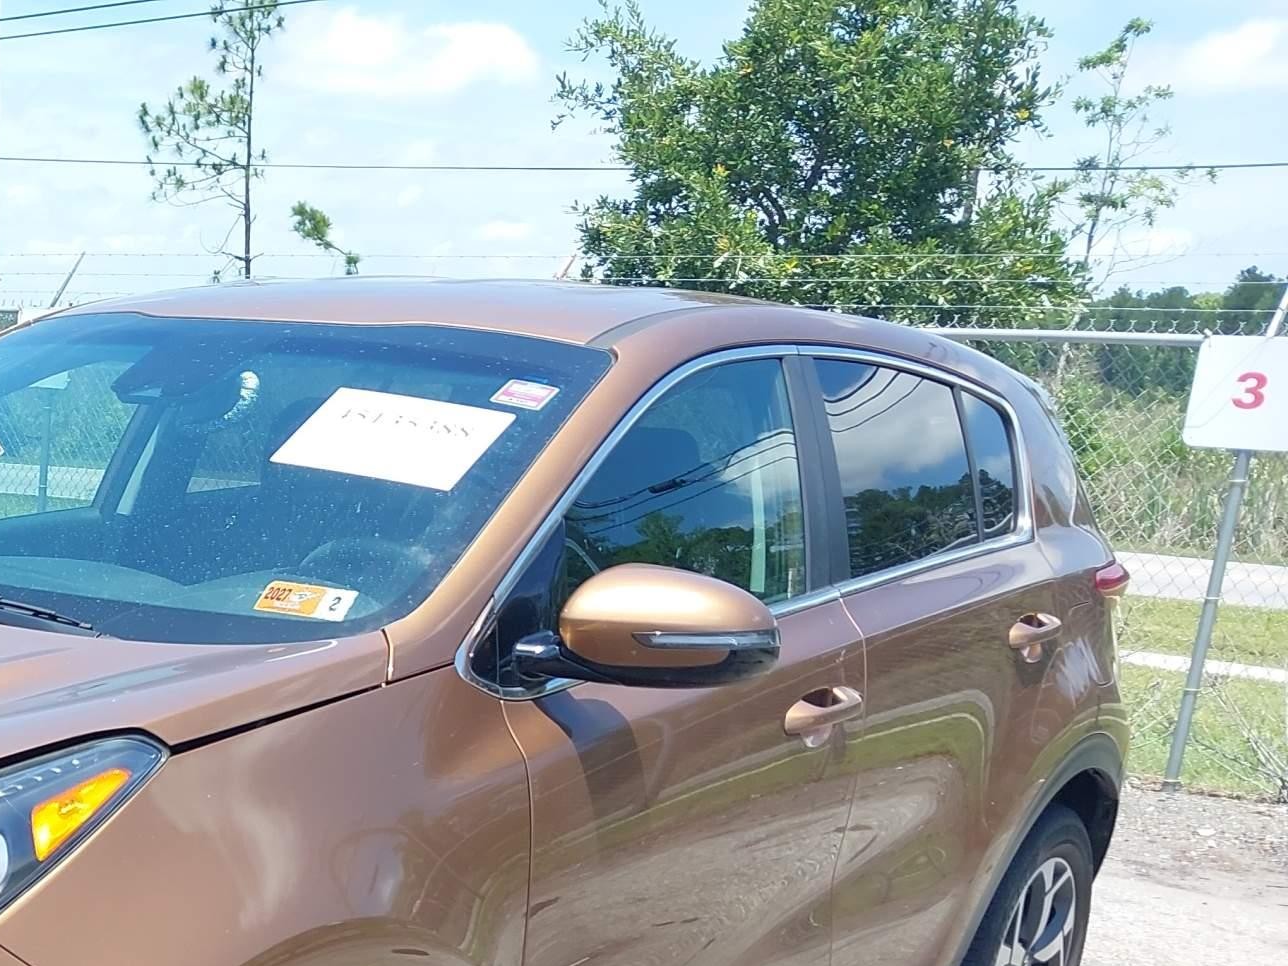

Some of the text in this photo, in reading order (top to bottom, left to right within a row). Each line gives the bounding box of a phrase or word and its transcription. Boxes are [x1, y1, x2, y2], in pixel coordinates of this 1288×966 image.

[1231, 371, 1268, 410] 3
[263, 586, 294, 602] 2027
[328, 596, 343, 612] 2
